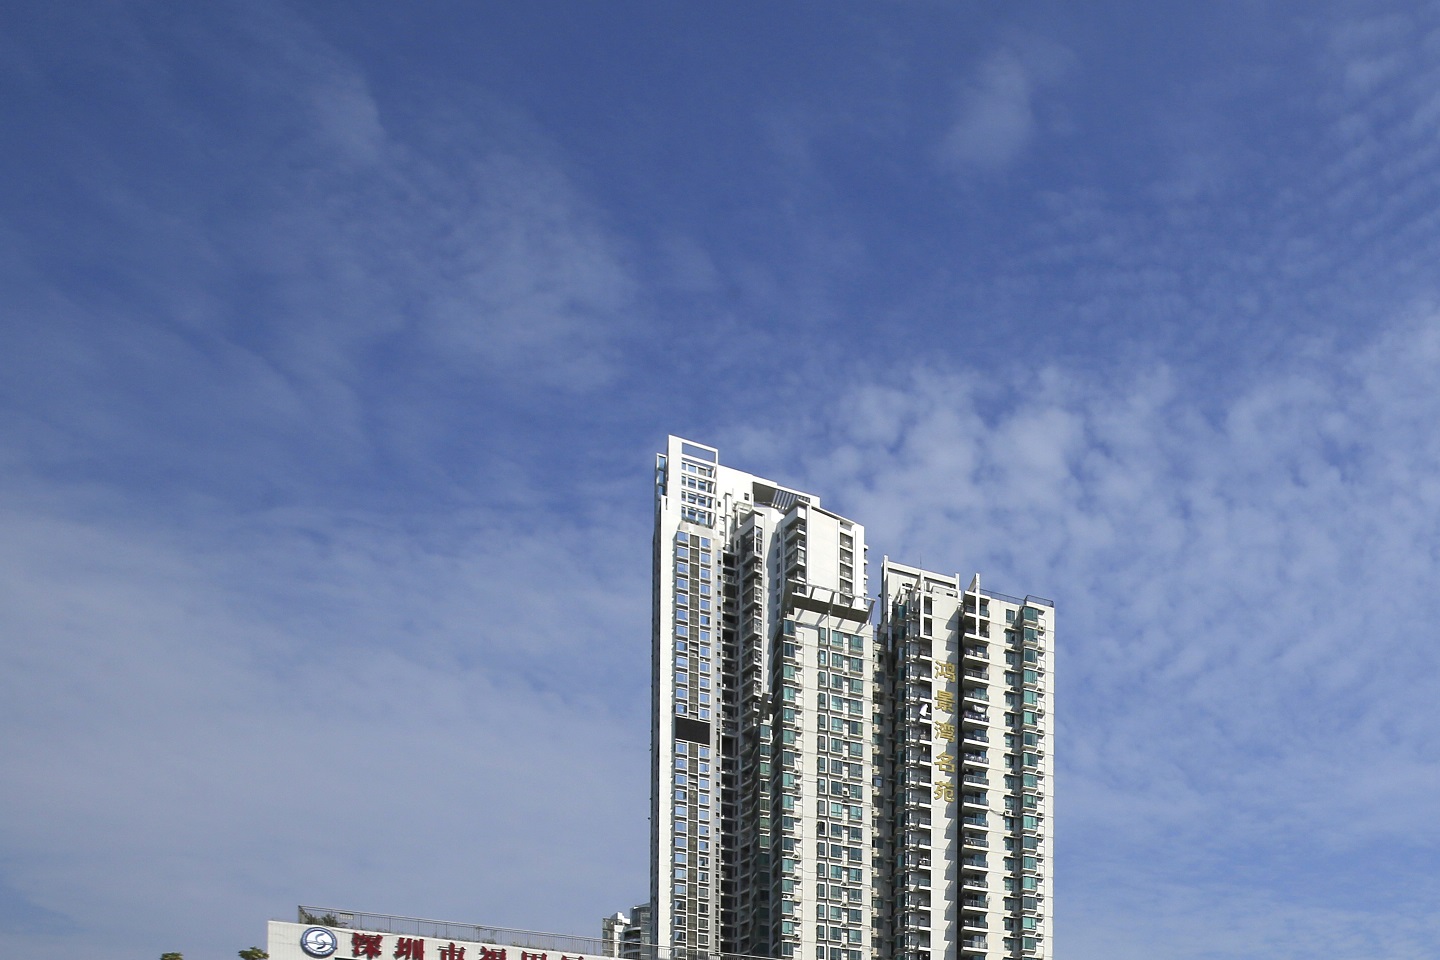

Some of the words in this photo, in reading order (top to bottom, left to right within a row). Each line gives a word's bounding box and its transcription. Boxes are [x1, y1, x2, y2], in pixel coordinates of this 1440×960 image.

[934, 661, 956, 802] 鸿景湾名苑
